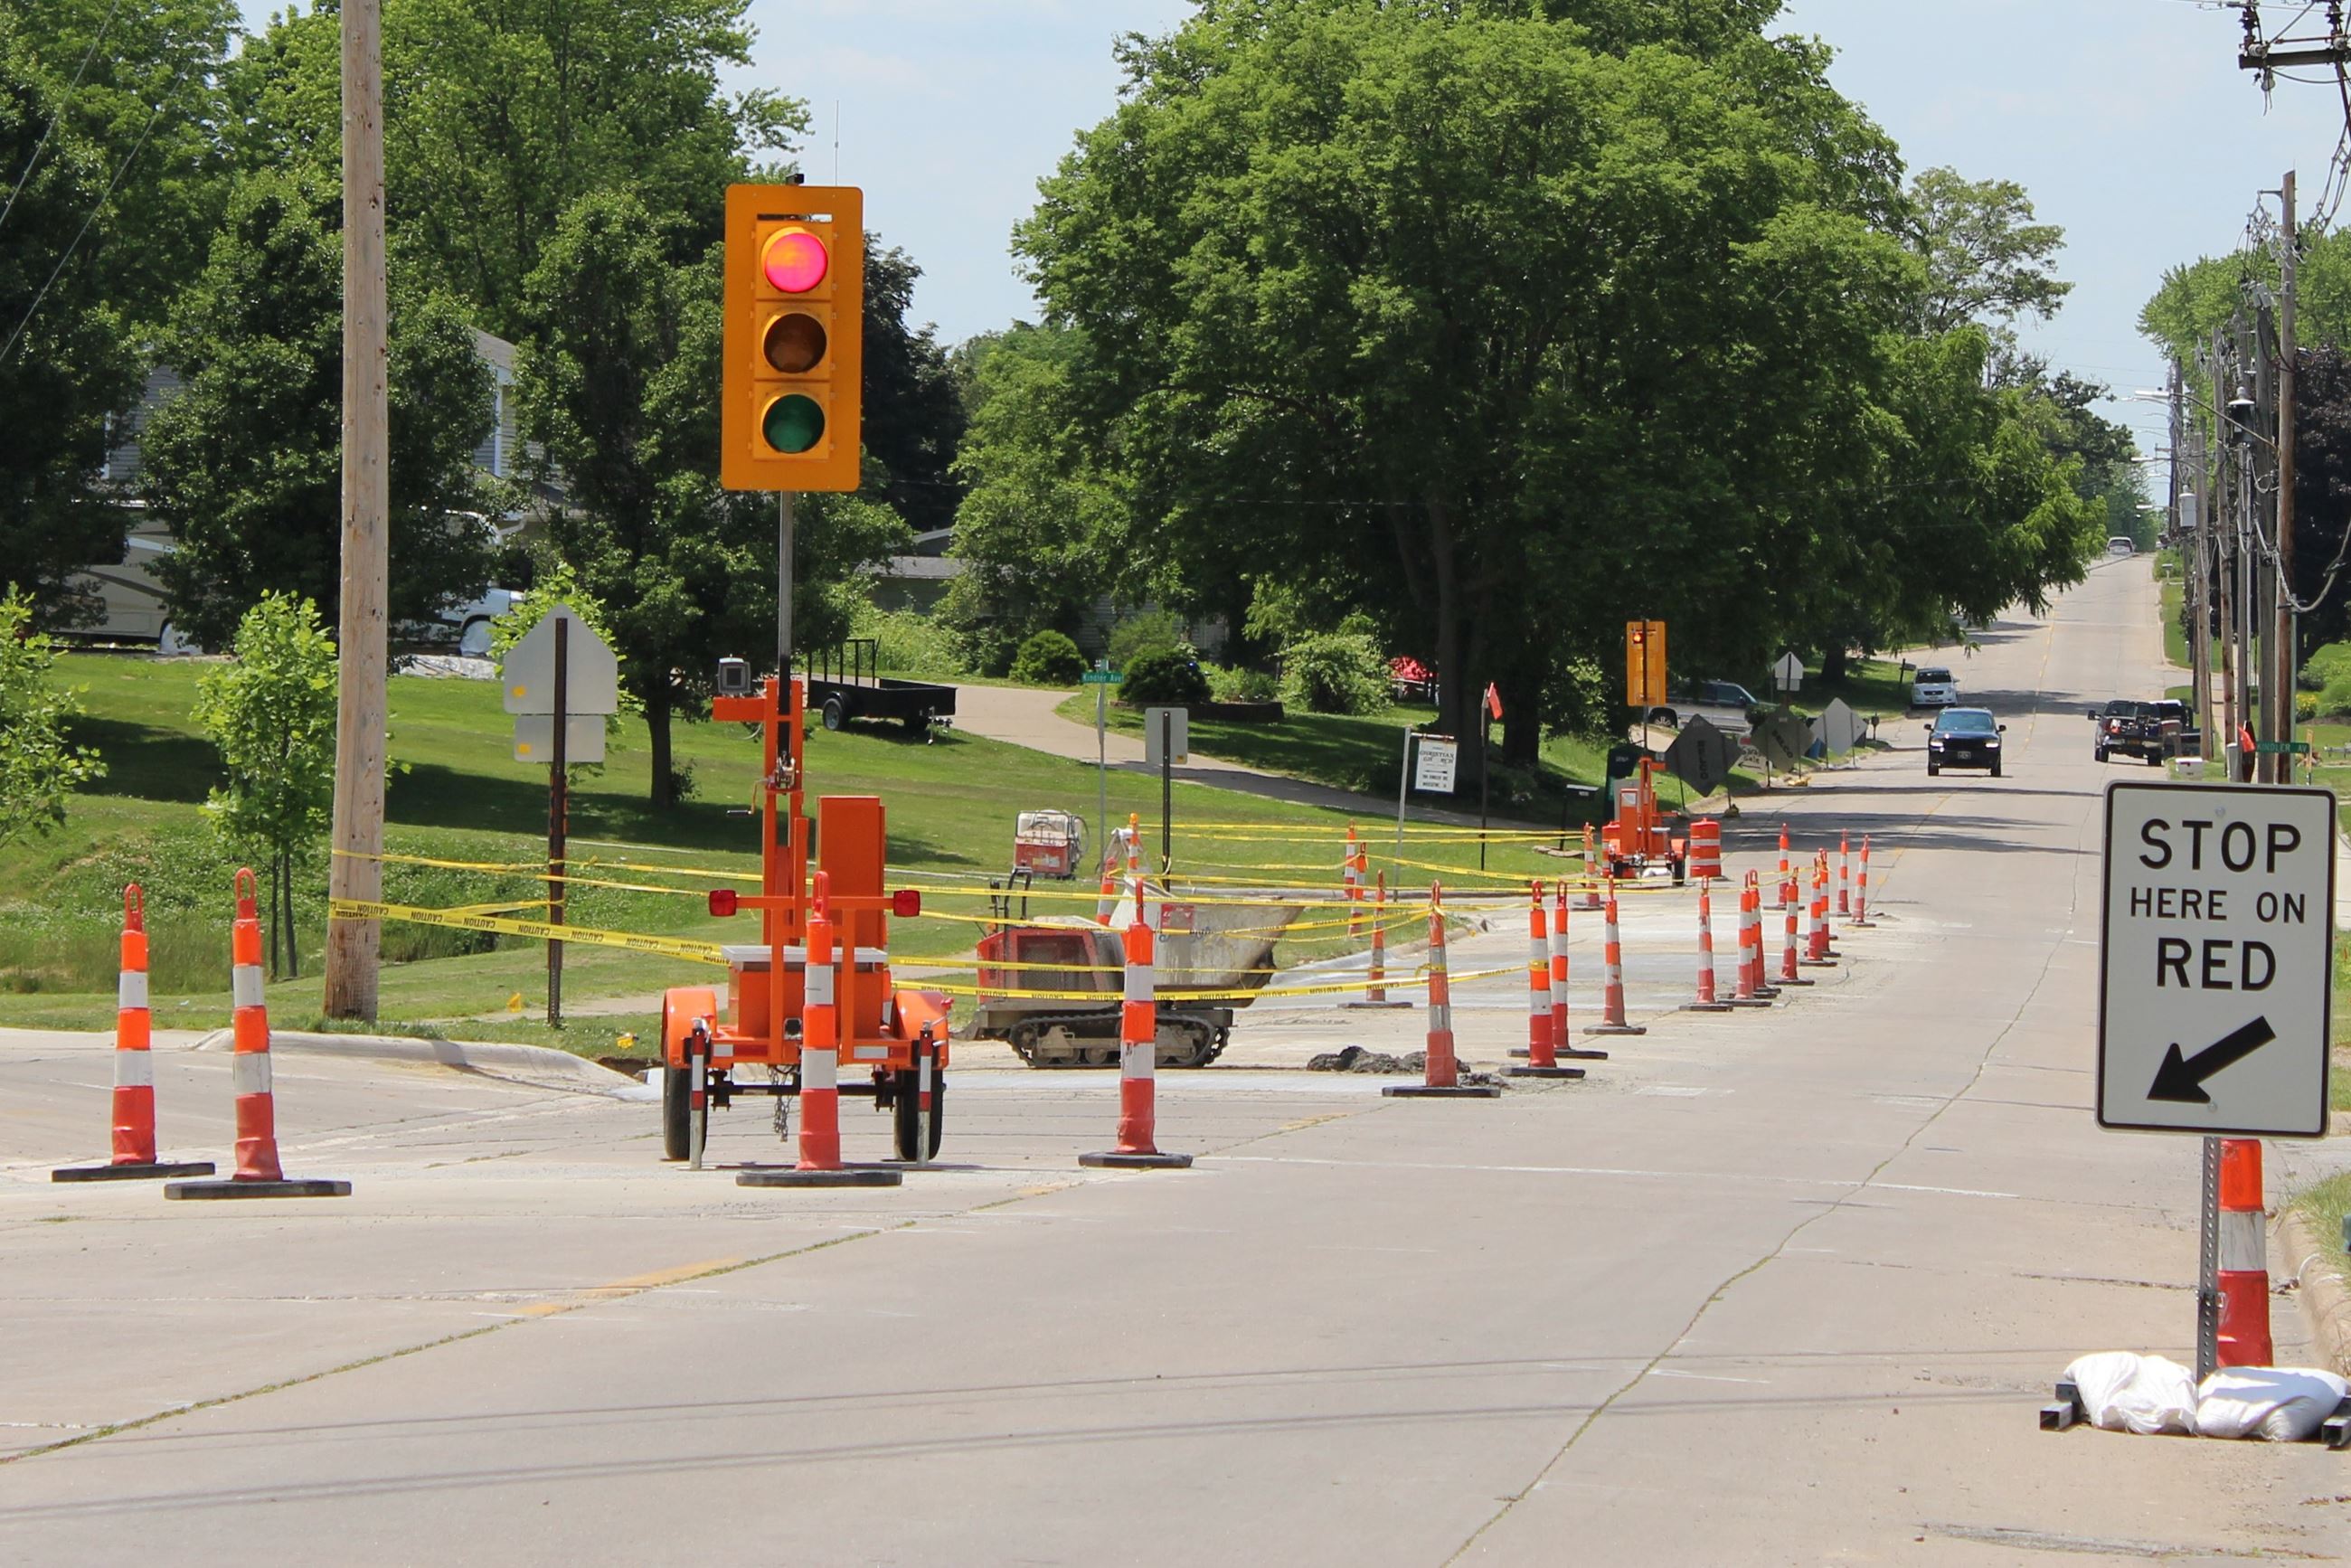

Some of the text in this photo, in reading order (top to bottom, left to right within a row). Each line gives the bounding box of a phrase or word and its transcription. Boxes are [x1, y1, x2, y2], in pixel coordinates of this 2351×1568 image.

[2139, 818, 2301, 874] STOP
[357, 903, 713, 955] CAUTION CAUTION CAUTION CAUTION CAUTION CAUTION CAUTION
[2130, 887, 2305, 924] HERE ON
[2157, 937, 2276, 991] RED
